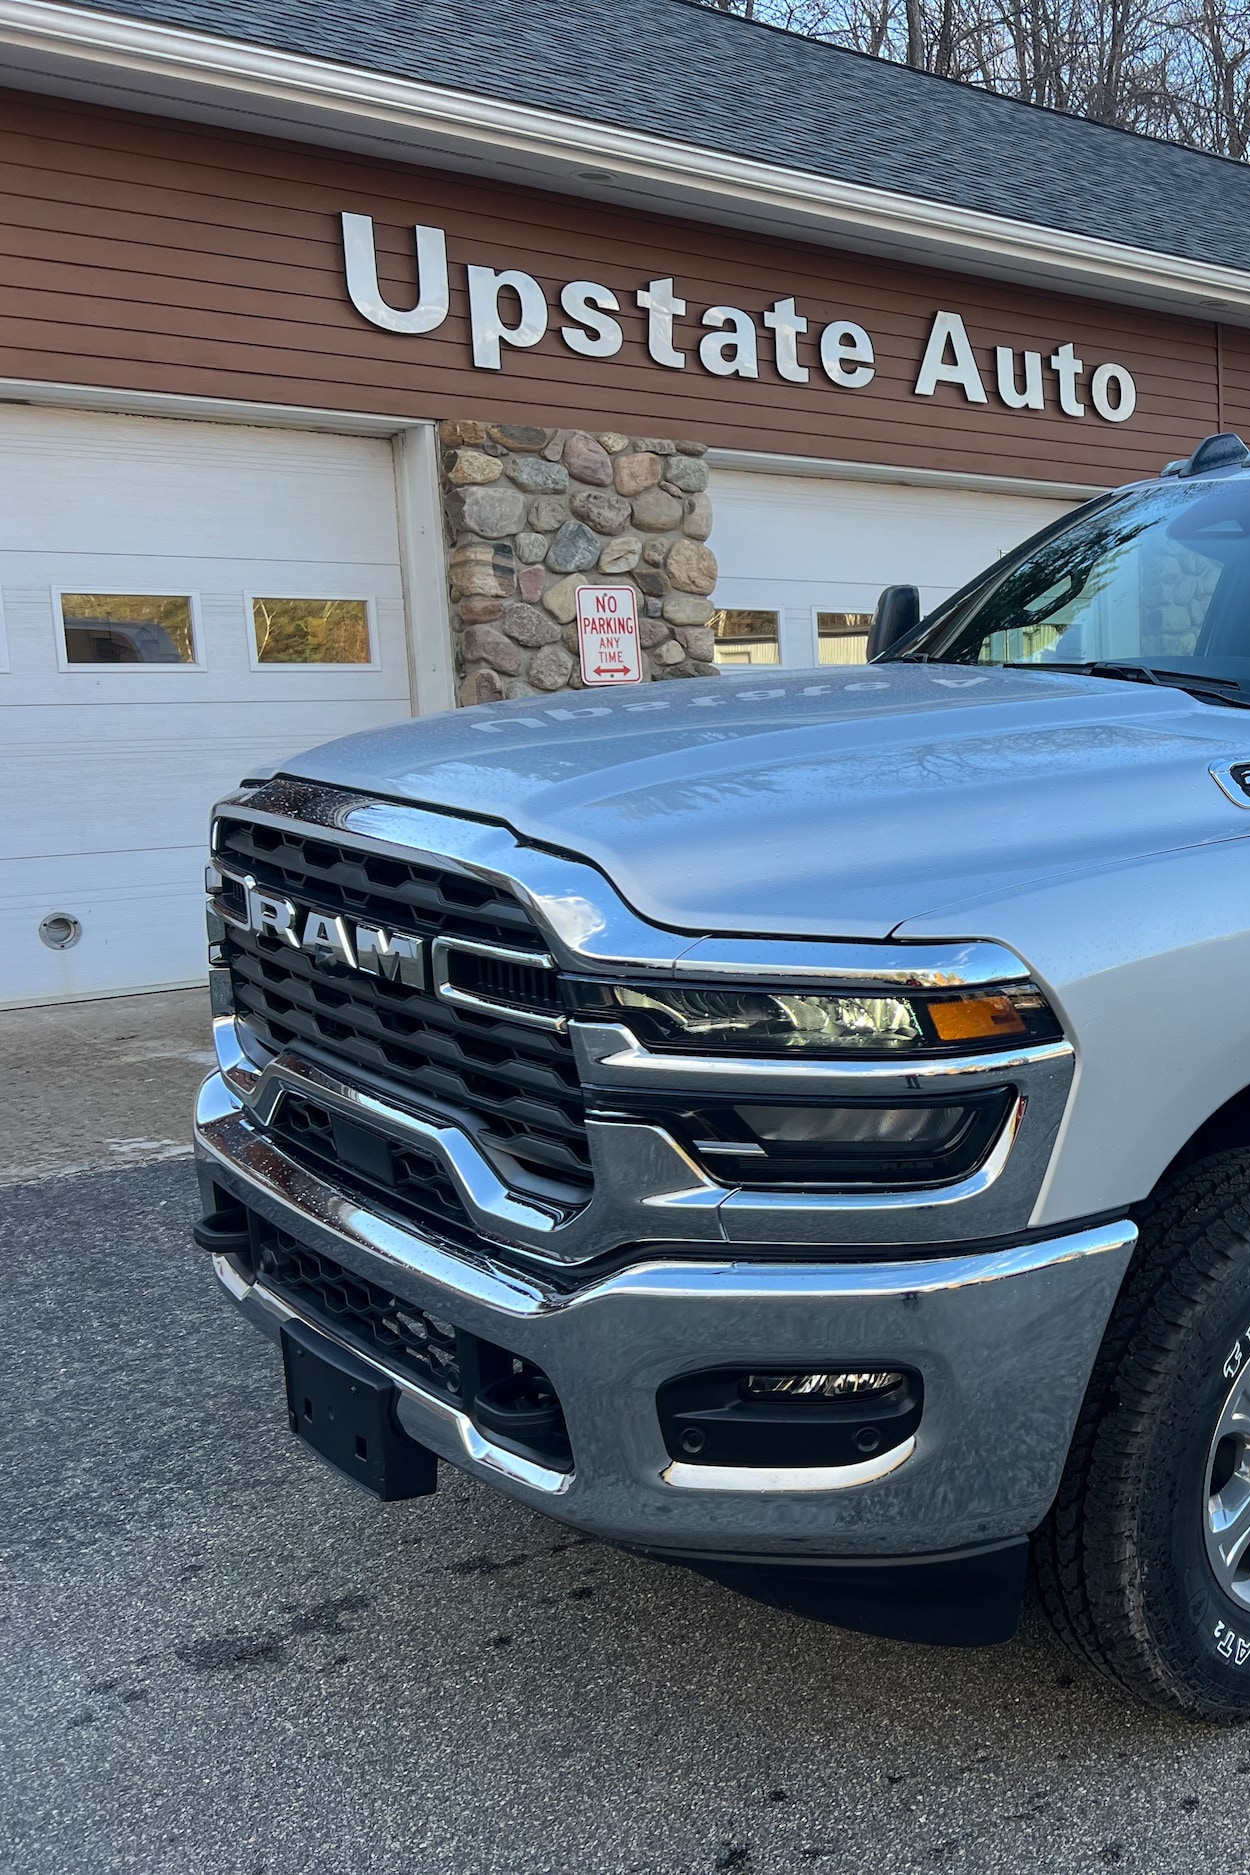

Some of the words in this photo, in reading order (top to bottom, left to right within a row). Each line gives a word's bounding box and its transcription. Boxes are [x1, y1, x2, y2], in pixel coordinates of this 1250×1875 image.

[340, 210, 876, 390] Upstate
[914, 310, 1138, 424] Auto
[595, 595, 618, 613] NO
[583, 617, 634, 635] PARKING
[599, 637, 620, 649] ANY
[598, 651, 624, 663] TIME
[250, 882, 429, 991] RAM
